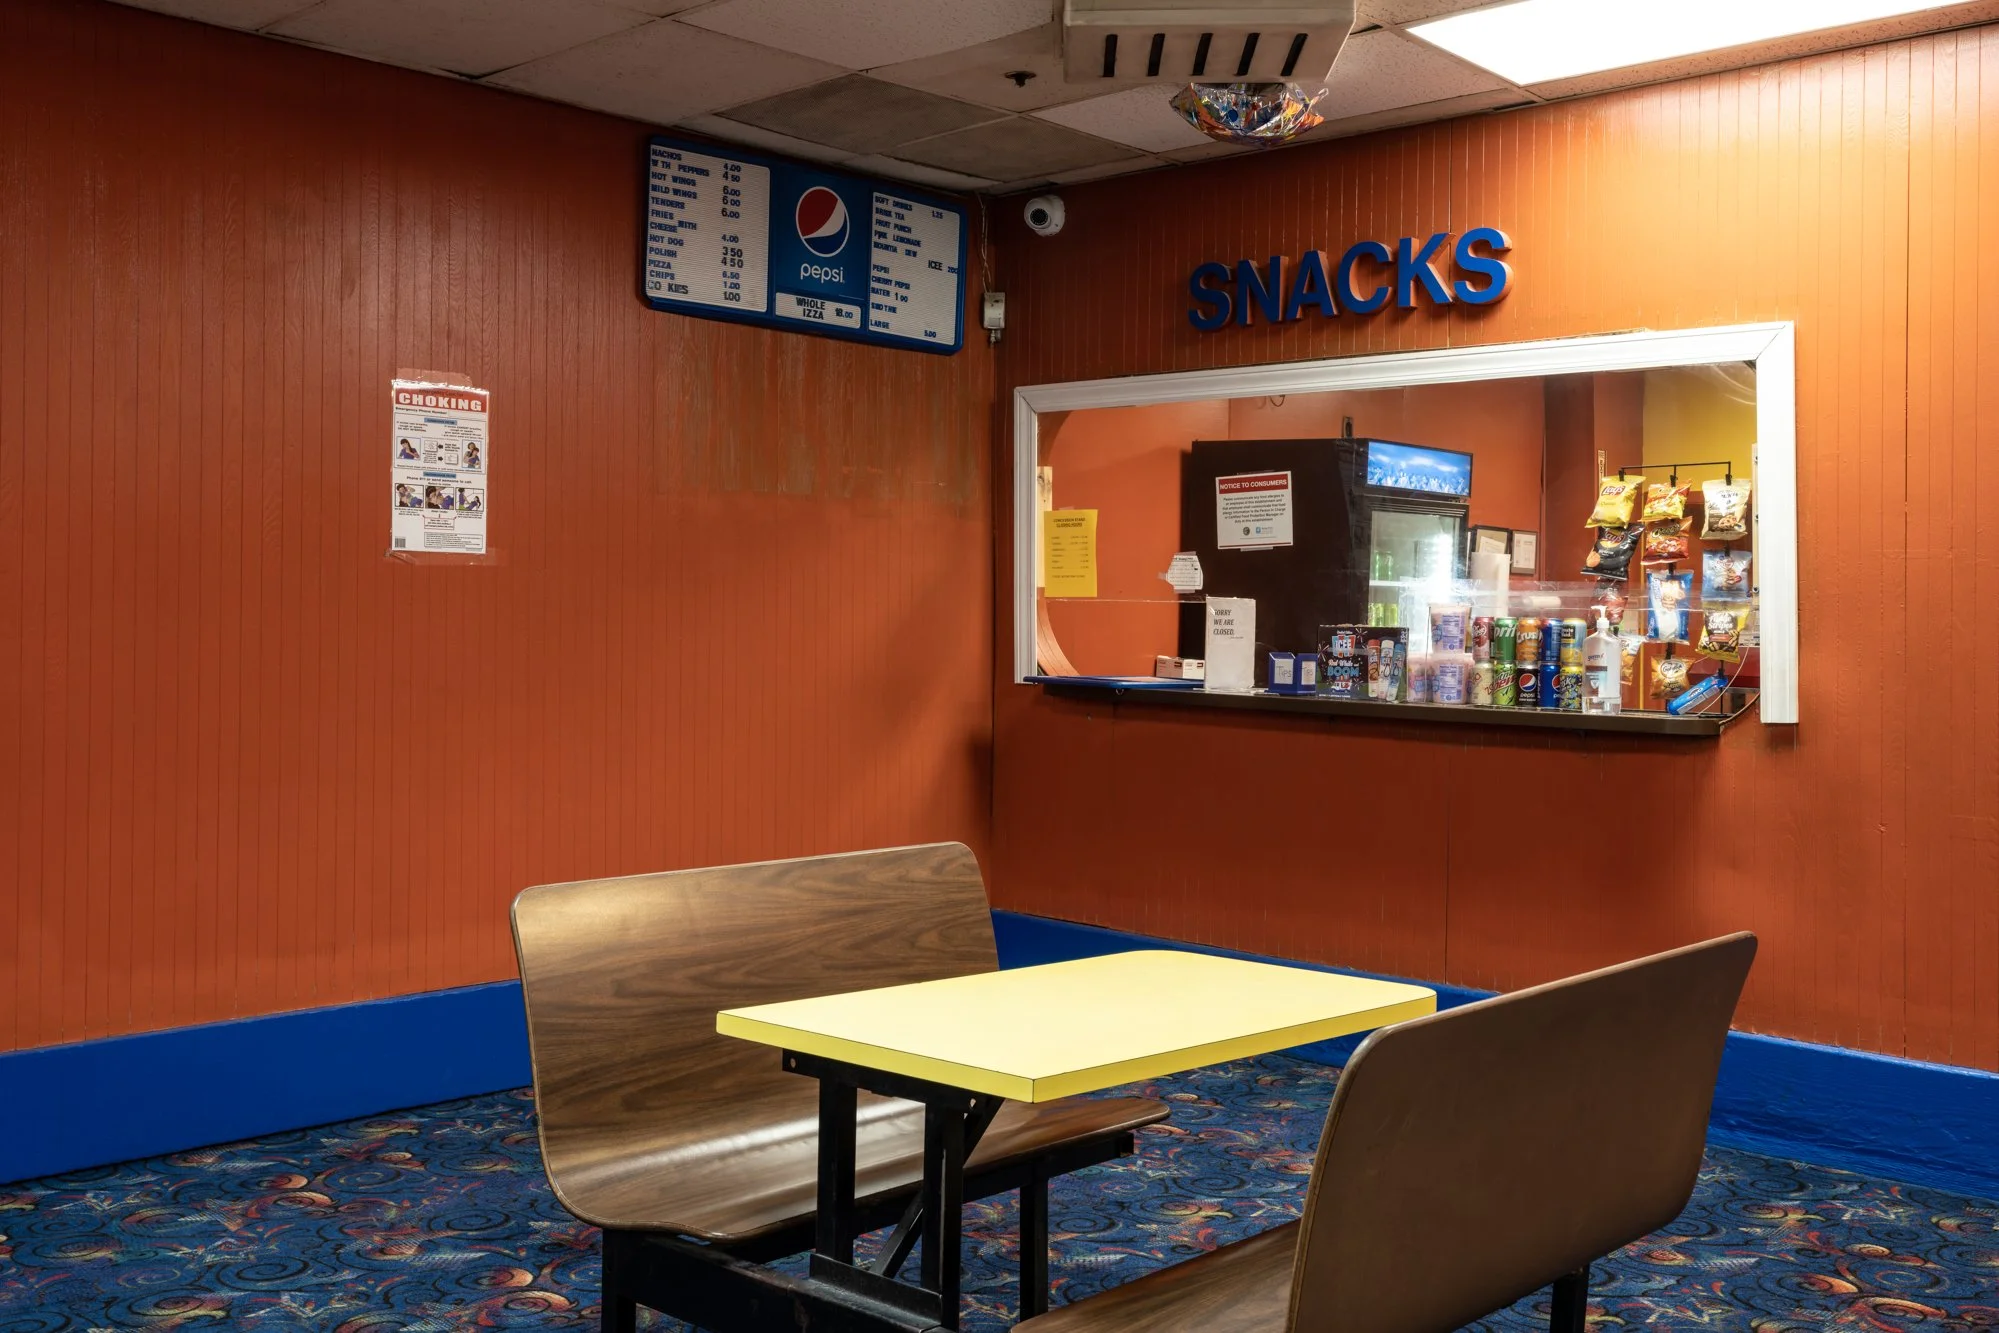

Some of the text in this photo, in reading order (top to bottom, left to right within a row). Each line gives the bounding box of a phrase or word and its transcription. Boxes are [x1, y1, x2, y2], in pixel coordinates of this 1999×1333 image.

[652, 148, 682, 160] NACHOS
[678, 164, 710, 176] PEPPERS
[651, 172, 696, 186] HOT WINGS
[651, 184, 697, 199] MILD WINGS
[723, 186, 740, 197] 6.00
[651, 197, 685, 209] TENDERS
[722, 208, 740, 218] 6.00
[895, 212, 904, 220] TEA
[652, 210, 697, 230] FRIES WITH
[650, 222, 677, 232] CHEESE
[876, 219, 912, 234] FRUIT PUNCH
[649, 234, 684, 246] HOT DOG
[722, 234, 739, 243] 4.00
[649, 247, 677, 258] POLISH
[648, 259, 671, 269] PIZZA
[873, 264, 889, 274] PEPSI
[928, 260, 943, 271] ICEE
[650, 270, 675, 280] CHIPS
[800, 263, 843, 283] pepsi
[872, 276, 910, 290] CHERRY PEPSI
[1188, 228, 1514, 331] SNACKS
[871, 287, 890, 297] WATER
[796, 297, 825, 310] WHOLE
[803, 308, 824, 319] IZZA
[870, 319, 890, 329] LARGE
[399, 393, 481, 411] CHOKING
[1250, 479, 1287, 487] CONSUMERS
[1335, 640, 1352, 650] ICEE
[1328, 666, 1360, 676] BOOM
